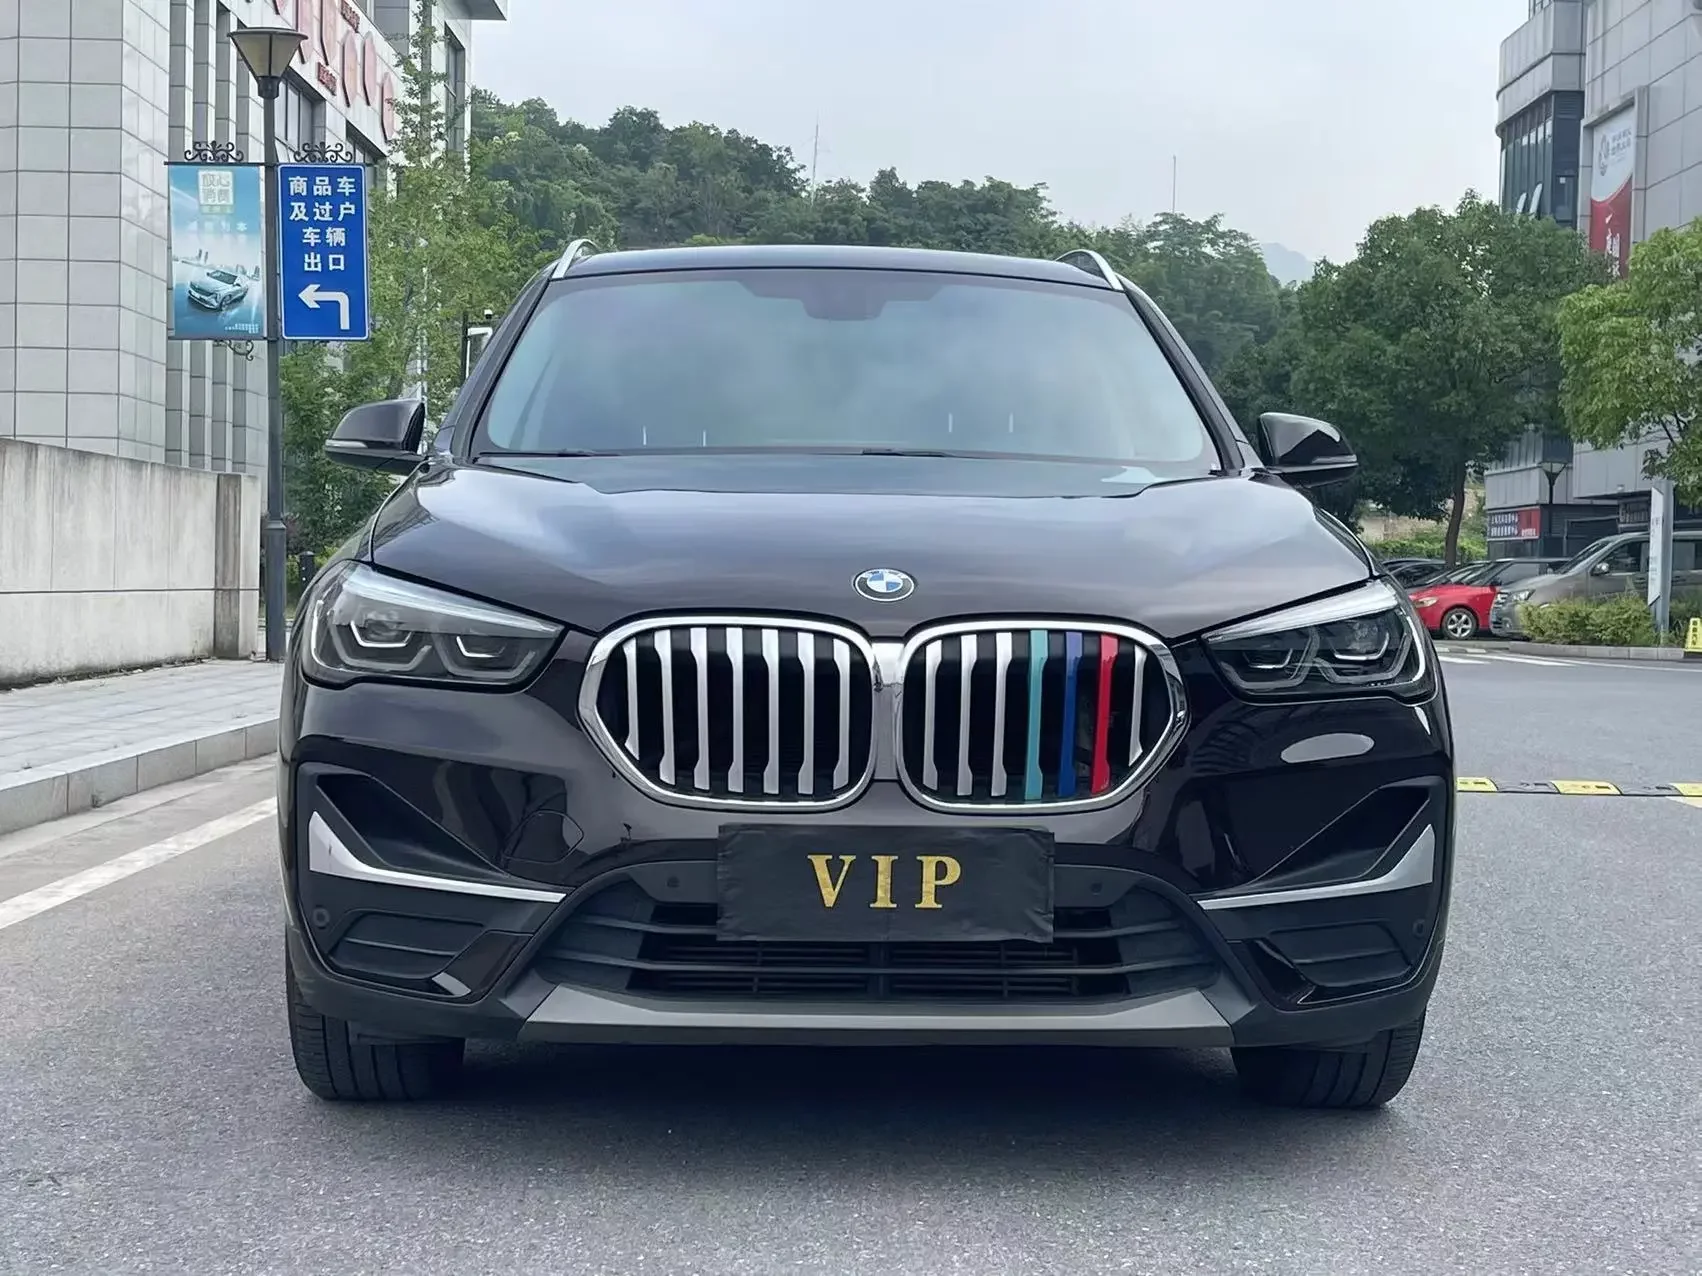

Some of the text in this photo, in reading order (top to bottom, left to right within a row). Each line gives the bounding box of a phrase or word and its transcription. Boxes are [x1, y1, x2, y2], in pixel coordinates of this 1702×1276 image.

[288, 176, 356, 196] 商品车
[290, 202, 355, 222] 及过户
[302, 227, 346, 247] 车辆
[303, 252, 345, 272] 出口
[807, 854, 962, 909] VIP
